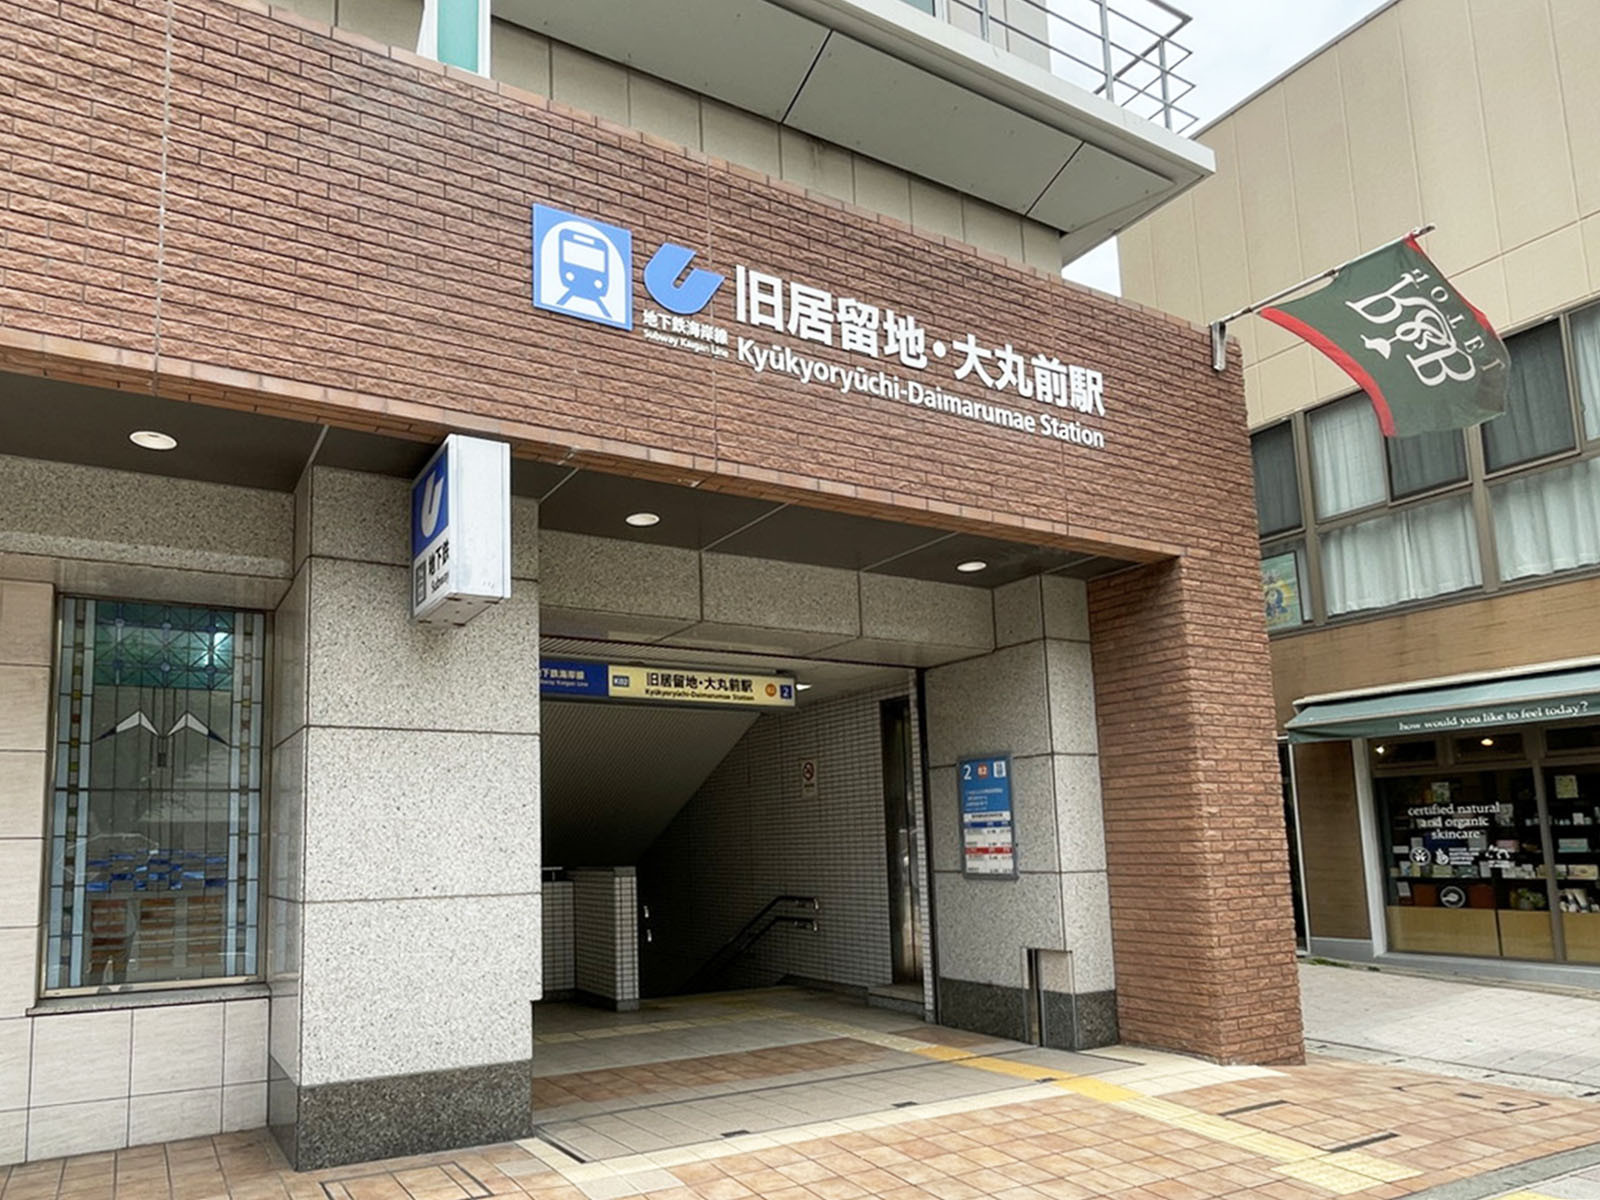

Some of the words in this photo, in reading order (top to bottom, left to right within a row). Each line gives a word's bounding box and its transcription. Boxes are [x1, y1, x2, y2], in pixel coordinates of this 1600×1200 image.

[735, 265, 1105, 417] 旧居留地・大丸前駅
[737, 336, 1035, 433] Kyūkyoryūchi-Daimarumae
[1040, 414, 1105, 448] Station
[1399, 722, 1420, 731] how
[1424, 716, 1458, 729] would
[1460, 716, 1481, 728] you
[1482, 711, 1504, 722] like
[1506, 711, 1519, 720] to
[1521, 707, 1542, 719] feel
[963, 765, 972, 780] 2
[1408, 803, 1454, 816] certified
[1457, 801, 1501, 814] natural
[1418, 816, 1443, 828] and
[1445, 816, 1490, 829] organic
[1431, 829, 1481, 840] skincare
